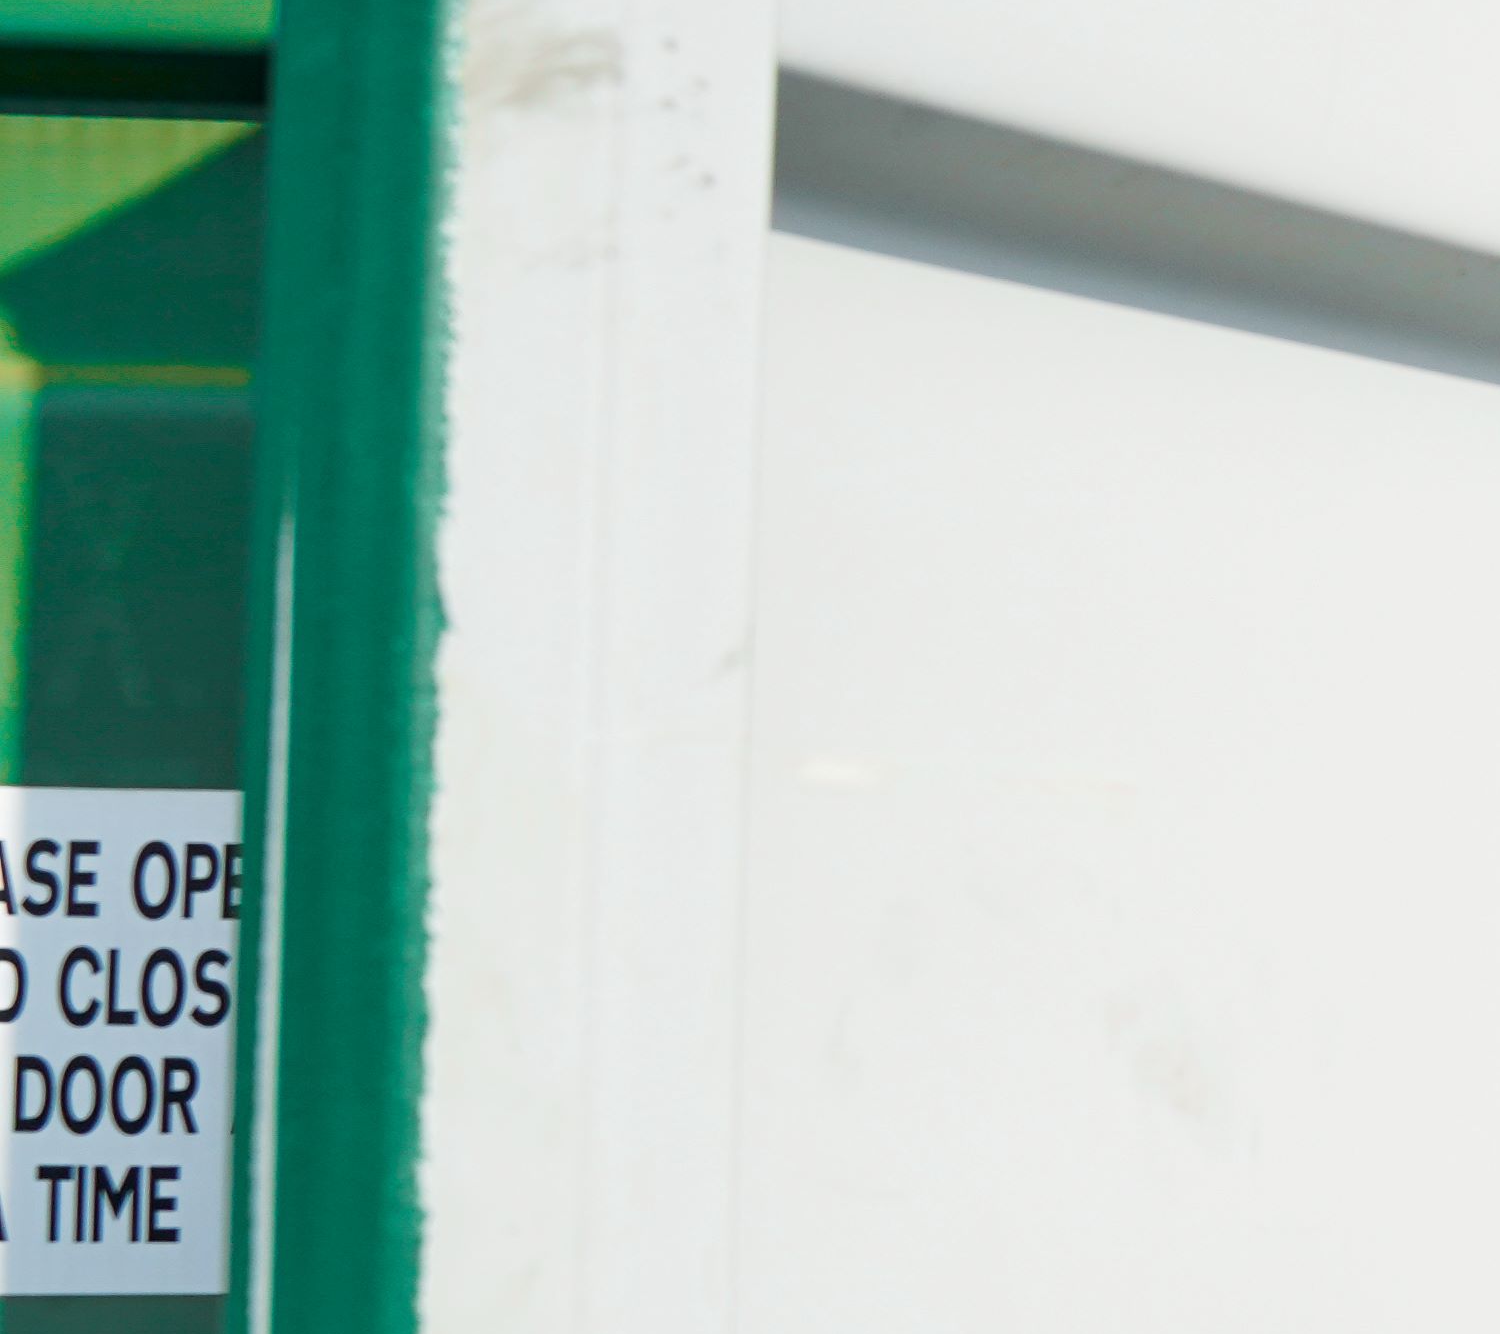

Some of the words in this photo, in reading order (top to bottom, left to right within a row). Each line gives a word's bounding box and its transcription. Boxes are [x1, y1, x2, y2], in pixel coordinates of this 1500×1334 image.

[132, 840, 242, 919] OPE
[58, 945, 231, 1028] CLOS
[14, 1054, 200, 1134] DOOR
[37, 1166, 182, 1243] TIME
